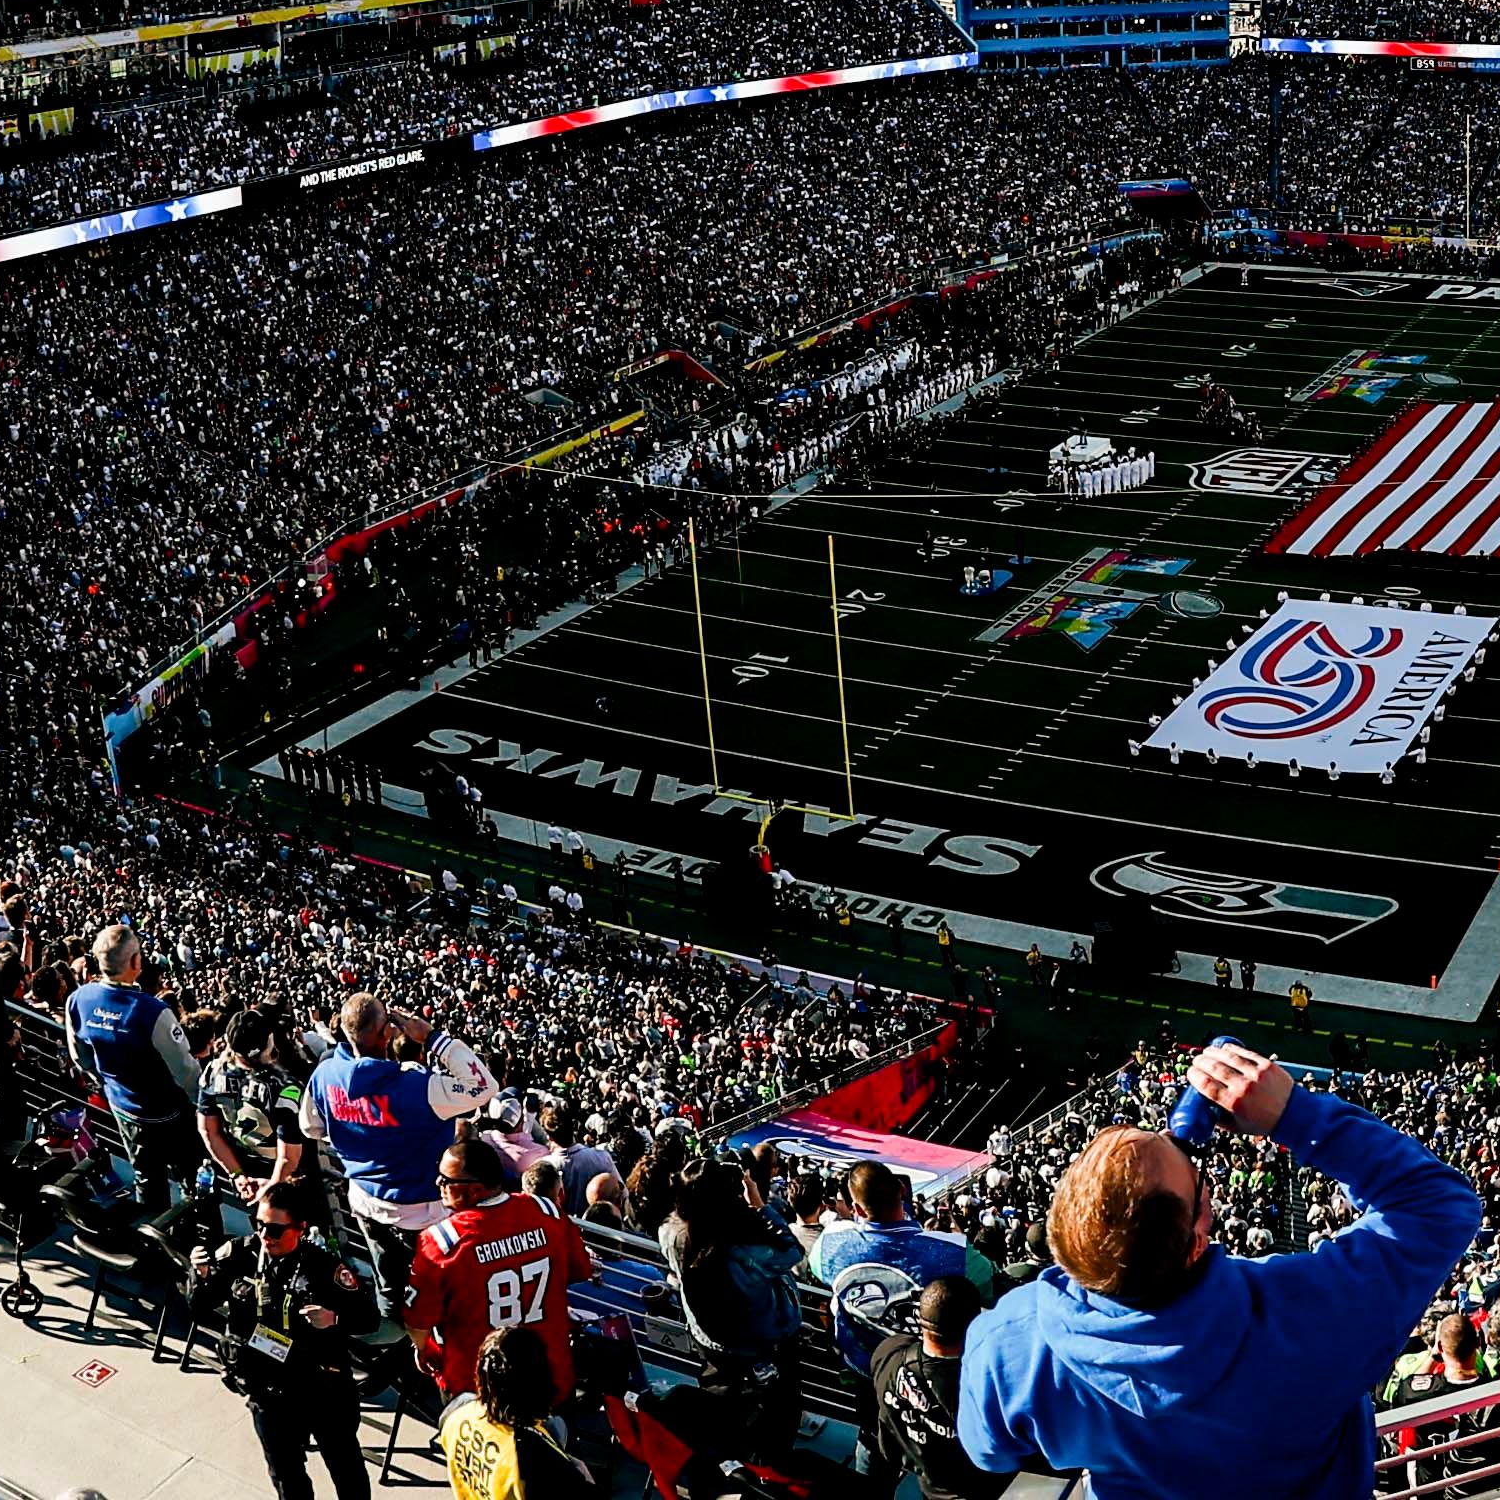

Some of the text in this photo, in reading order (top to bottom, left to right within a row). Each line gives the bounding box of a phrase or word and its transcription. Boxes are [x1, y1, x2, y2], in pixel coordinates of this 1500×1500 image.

[1042, 557, 1094, 595] SUPER
[1350, 630, 1471, 747] AMERICA
[413, 728, 1043, 876] SEAHAWKS
[475, 1227, 547, 1264] GRONKOWSKI
[486, 1256, 550, 1329] 87
[454, 1439, 493, 1488] EVENT
[458, 1419, 501, 1465] CSC
